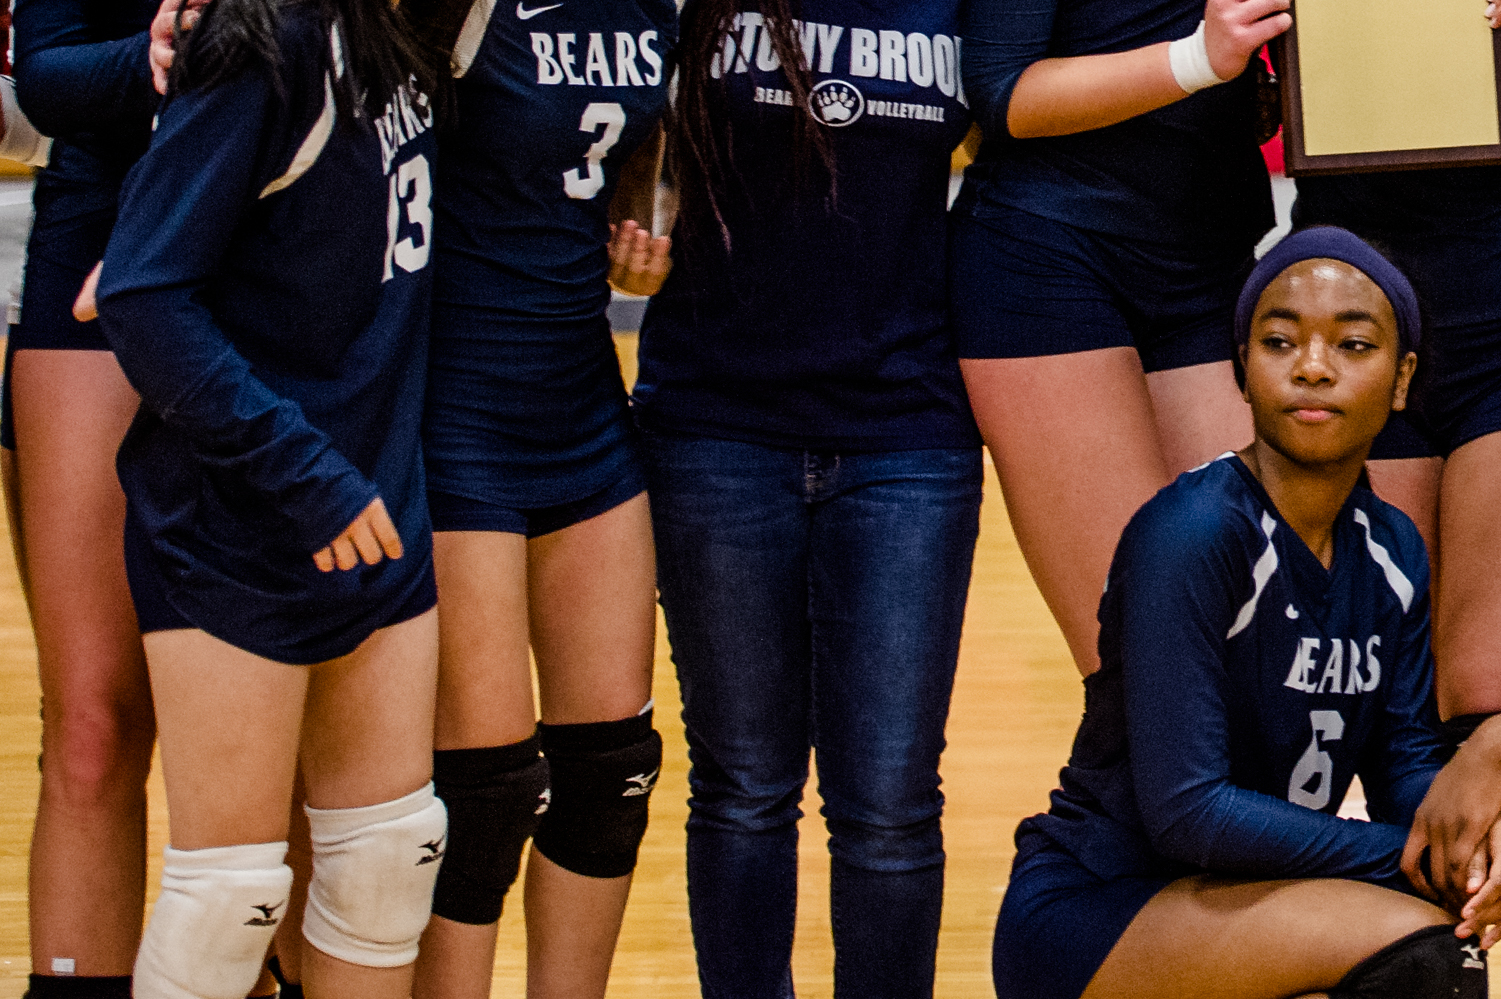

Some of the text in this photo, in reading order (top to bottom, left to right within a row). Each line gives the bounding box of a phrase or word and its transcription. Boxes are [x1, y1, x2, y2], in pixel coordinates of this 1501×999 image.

[529, 29, 664, 87] BEARS
[563, 102, 627, 200] 3
[866, 99, 945, 123] VOLLEYBALL
[381, 154, 434, 283] 13
[1288, 710, 1346, 811] 6
